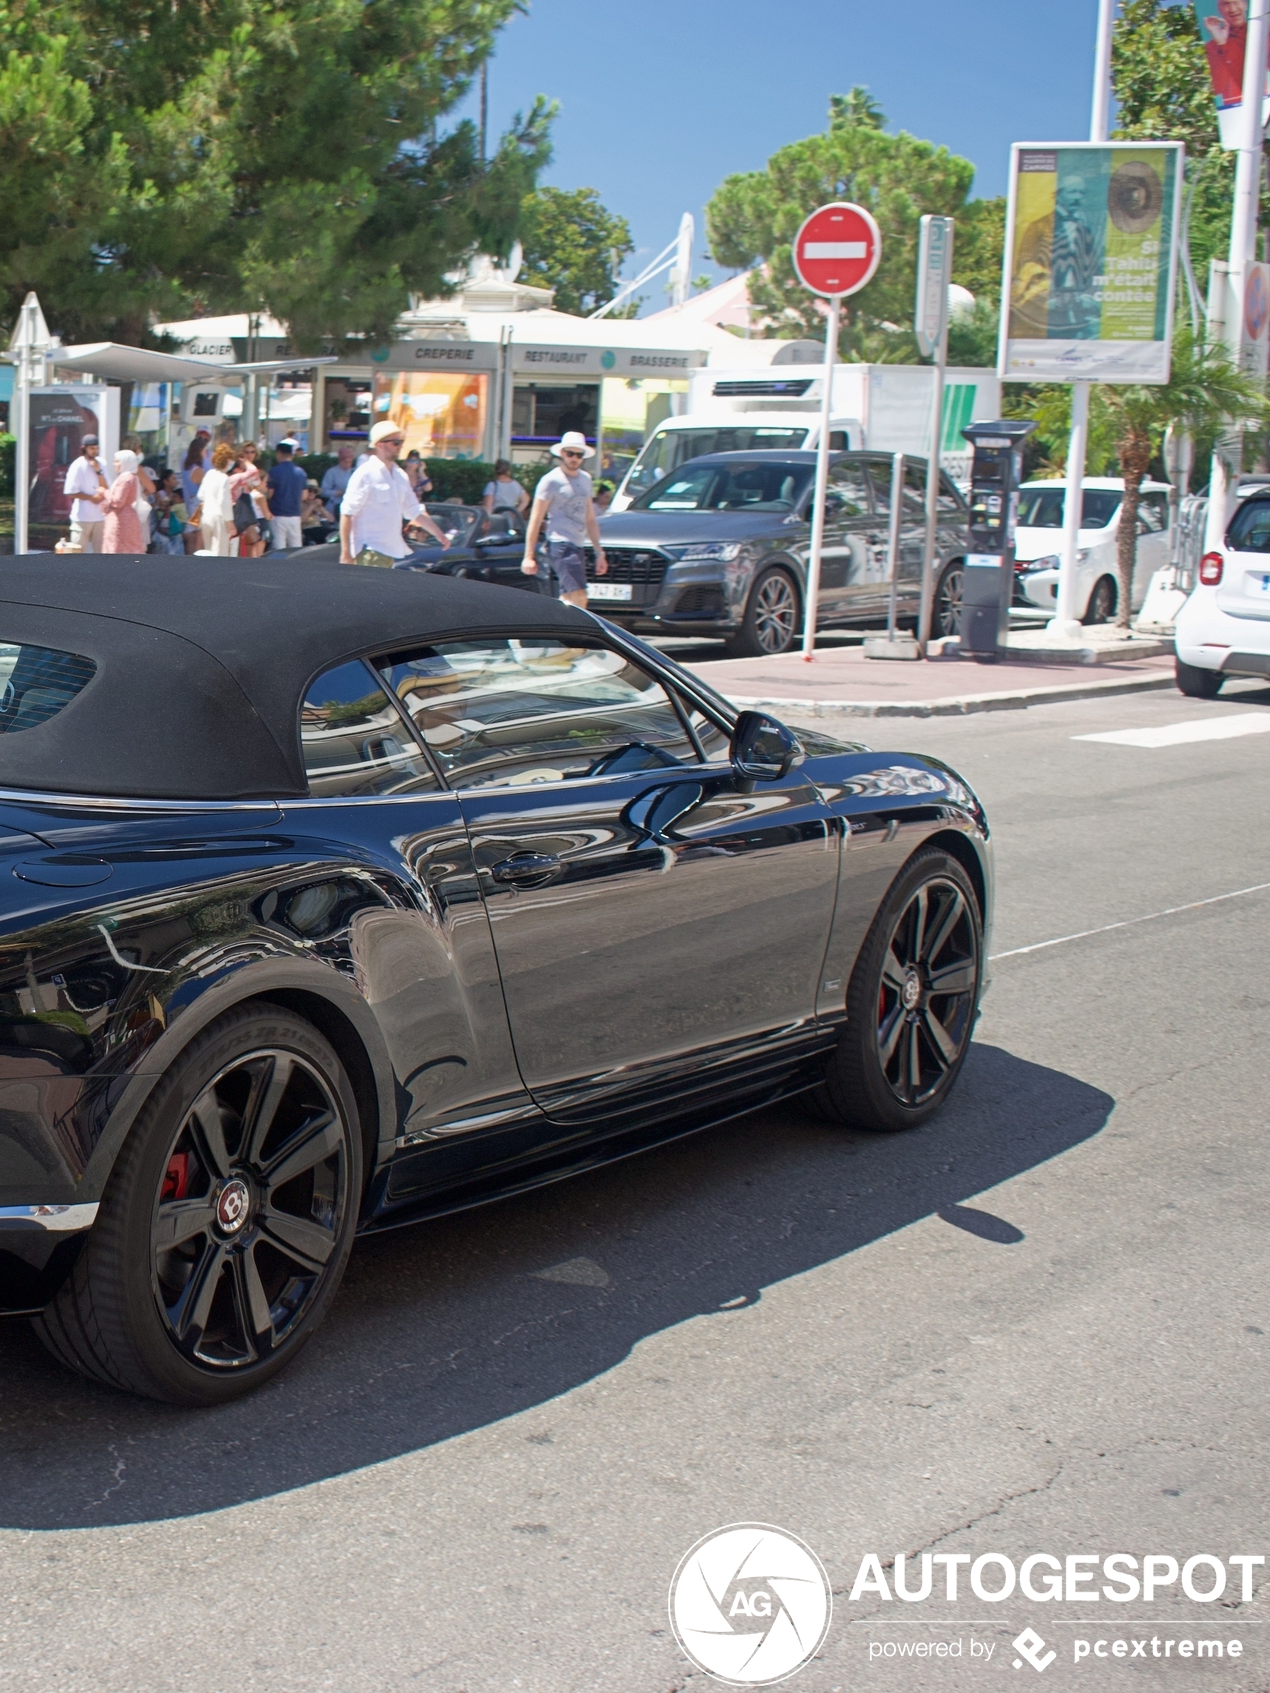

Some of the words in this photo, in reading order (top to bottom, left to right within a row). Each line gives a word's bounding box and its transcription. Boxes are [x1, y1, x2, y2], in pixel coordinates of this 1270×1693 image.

[1105, 256, 1158, 270] Tahiti
[1093, 288, 1154, 302] contée
[190, 344, 232, 355] GLACIER
[415, 347, 474, 361] CREPERIE
[524, 350, 587, 364] RESTAURANT
[630, 355, 689, 368] BRASSERIE
